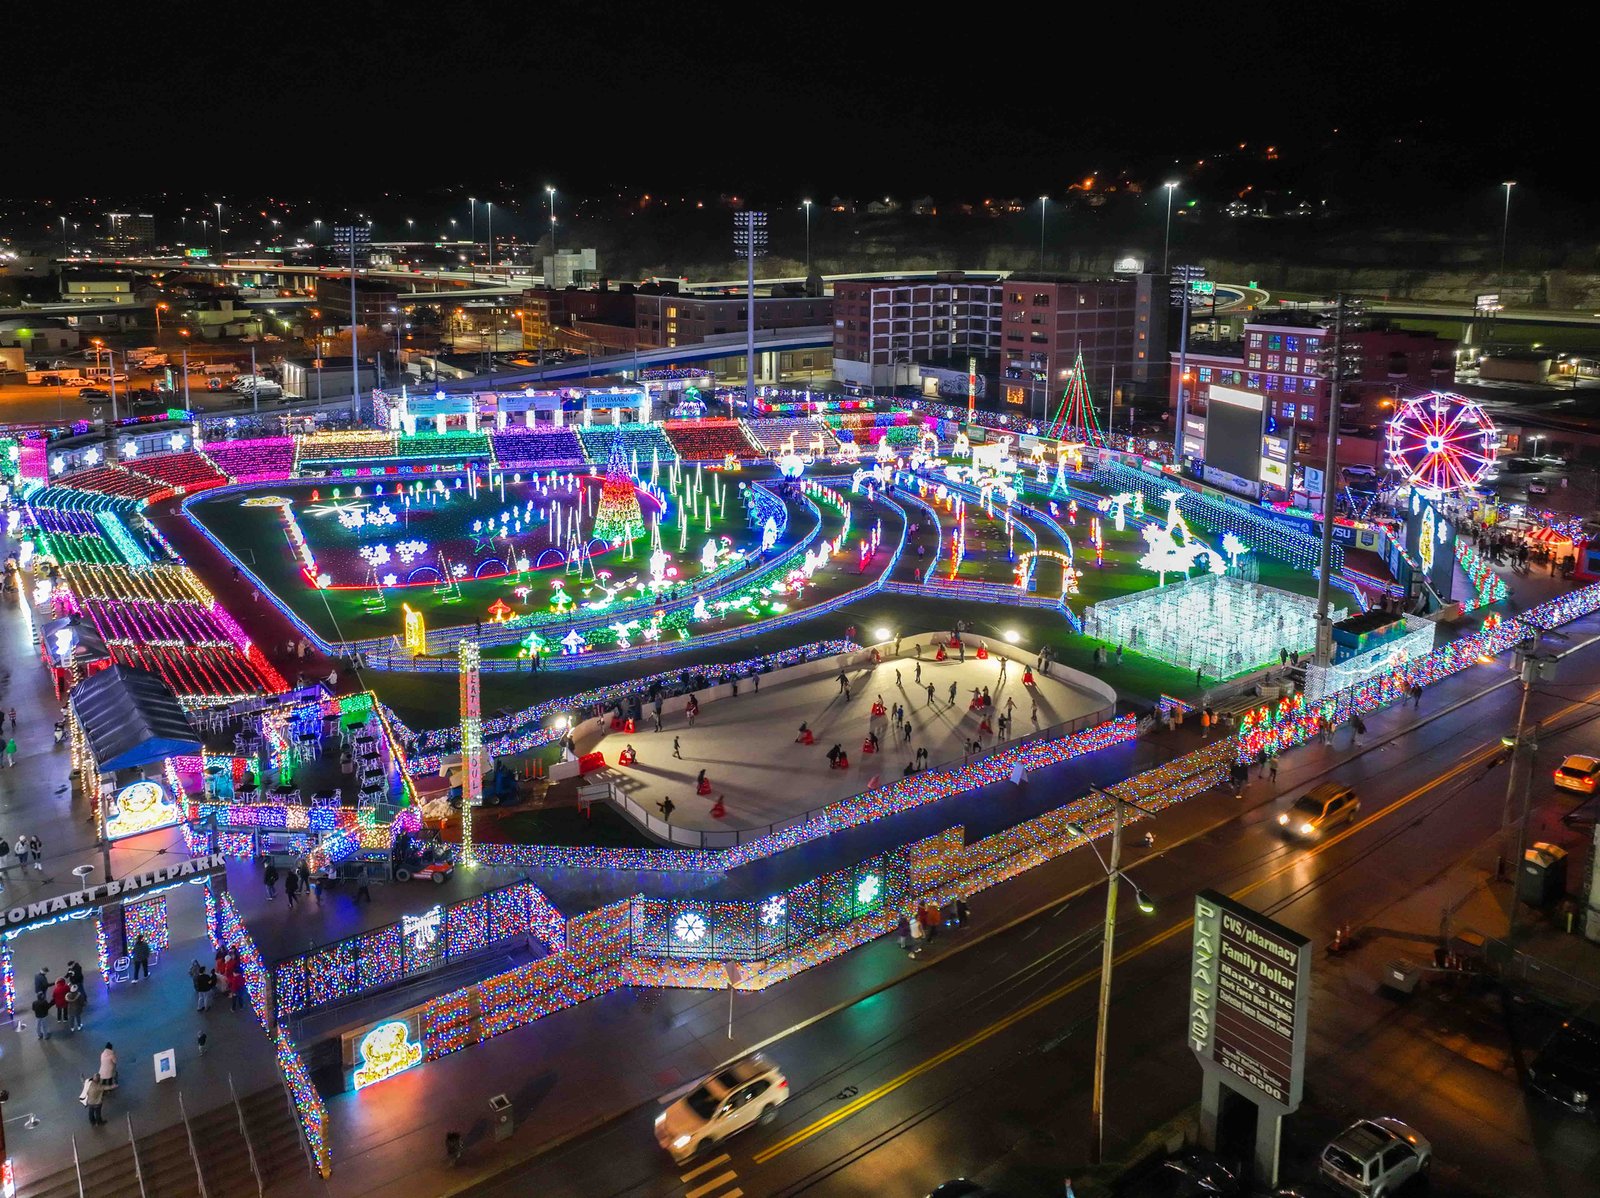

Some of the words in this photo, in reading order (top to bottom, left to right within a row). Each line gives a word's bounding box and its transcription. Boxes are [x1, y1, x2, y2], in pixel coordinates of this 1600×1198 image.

[591, 395, 631, 404] HIGHMARK
[469, 675, 478, 704] EAT
[106, 851, 226, 897] BALLPARK
[1193, 902, 1214, 985] PLAZA
[1223, 914, 1297, 967] CVS/pharmacy
[1220, 963, 1266, 995] Marty's
[1268, 988, 1293, 1010] Tire
[1221, 940, 1258, 974] Family
[1259, 961, 1295, 990] Dollar
[1191, 986, 1210, 1052] EAST
[1219, 975, 1235, 992] Work
[1235, 985, 1252, 1001] Force
[1252, 994, 1268, 1009] West
[1268, 1003, 1292, 1023] Virginia
[1221, 1056, 1282, 1100] 345-0500
